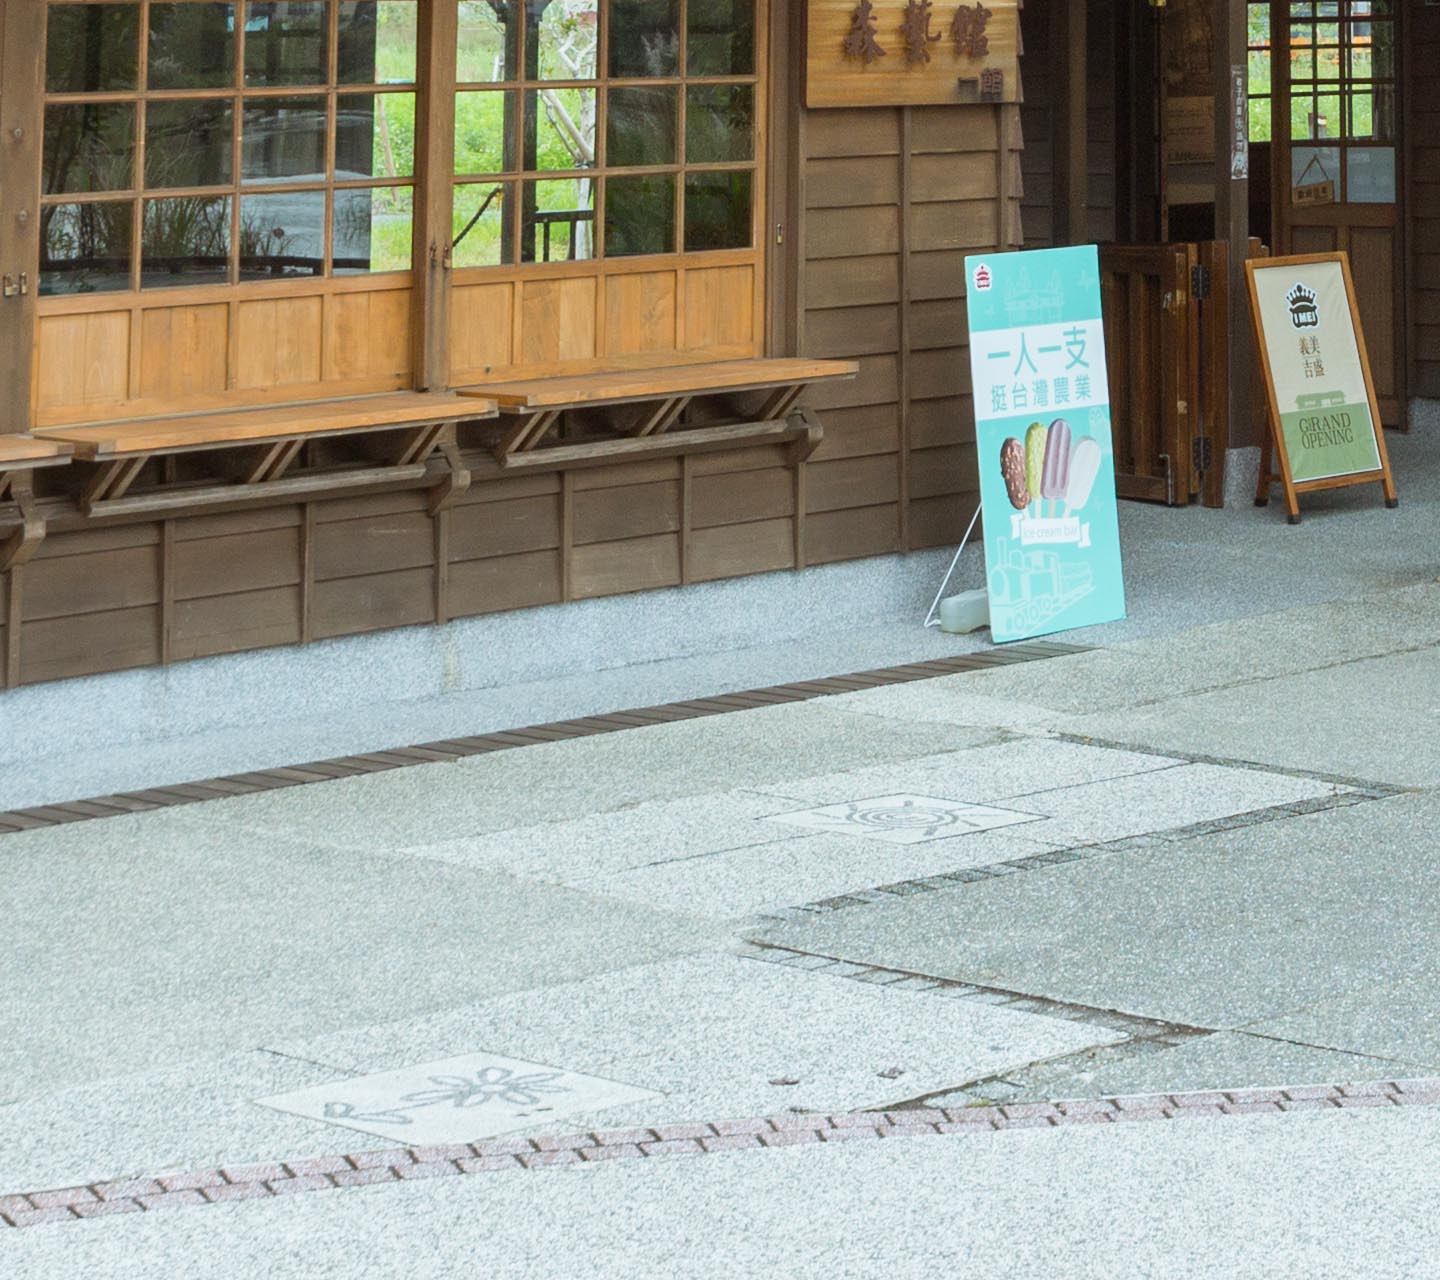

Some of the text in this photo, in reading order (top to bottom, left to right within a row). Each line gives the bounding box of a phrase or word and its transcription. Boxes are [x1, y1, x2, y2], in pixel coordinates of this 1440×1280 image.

[987, 326, 1090, 376] 一人一支
[991, 375, 1092, 412] 挺台灣農業
[1299, 412, 1352, 433] GRAND
[1301, 427, 1354, 450] OPENING
